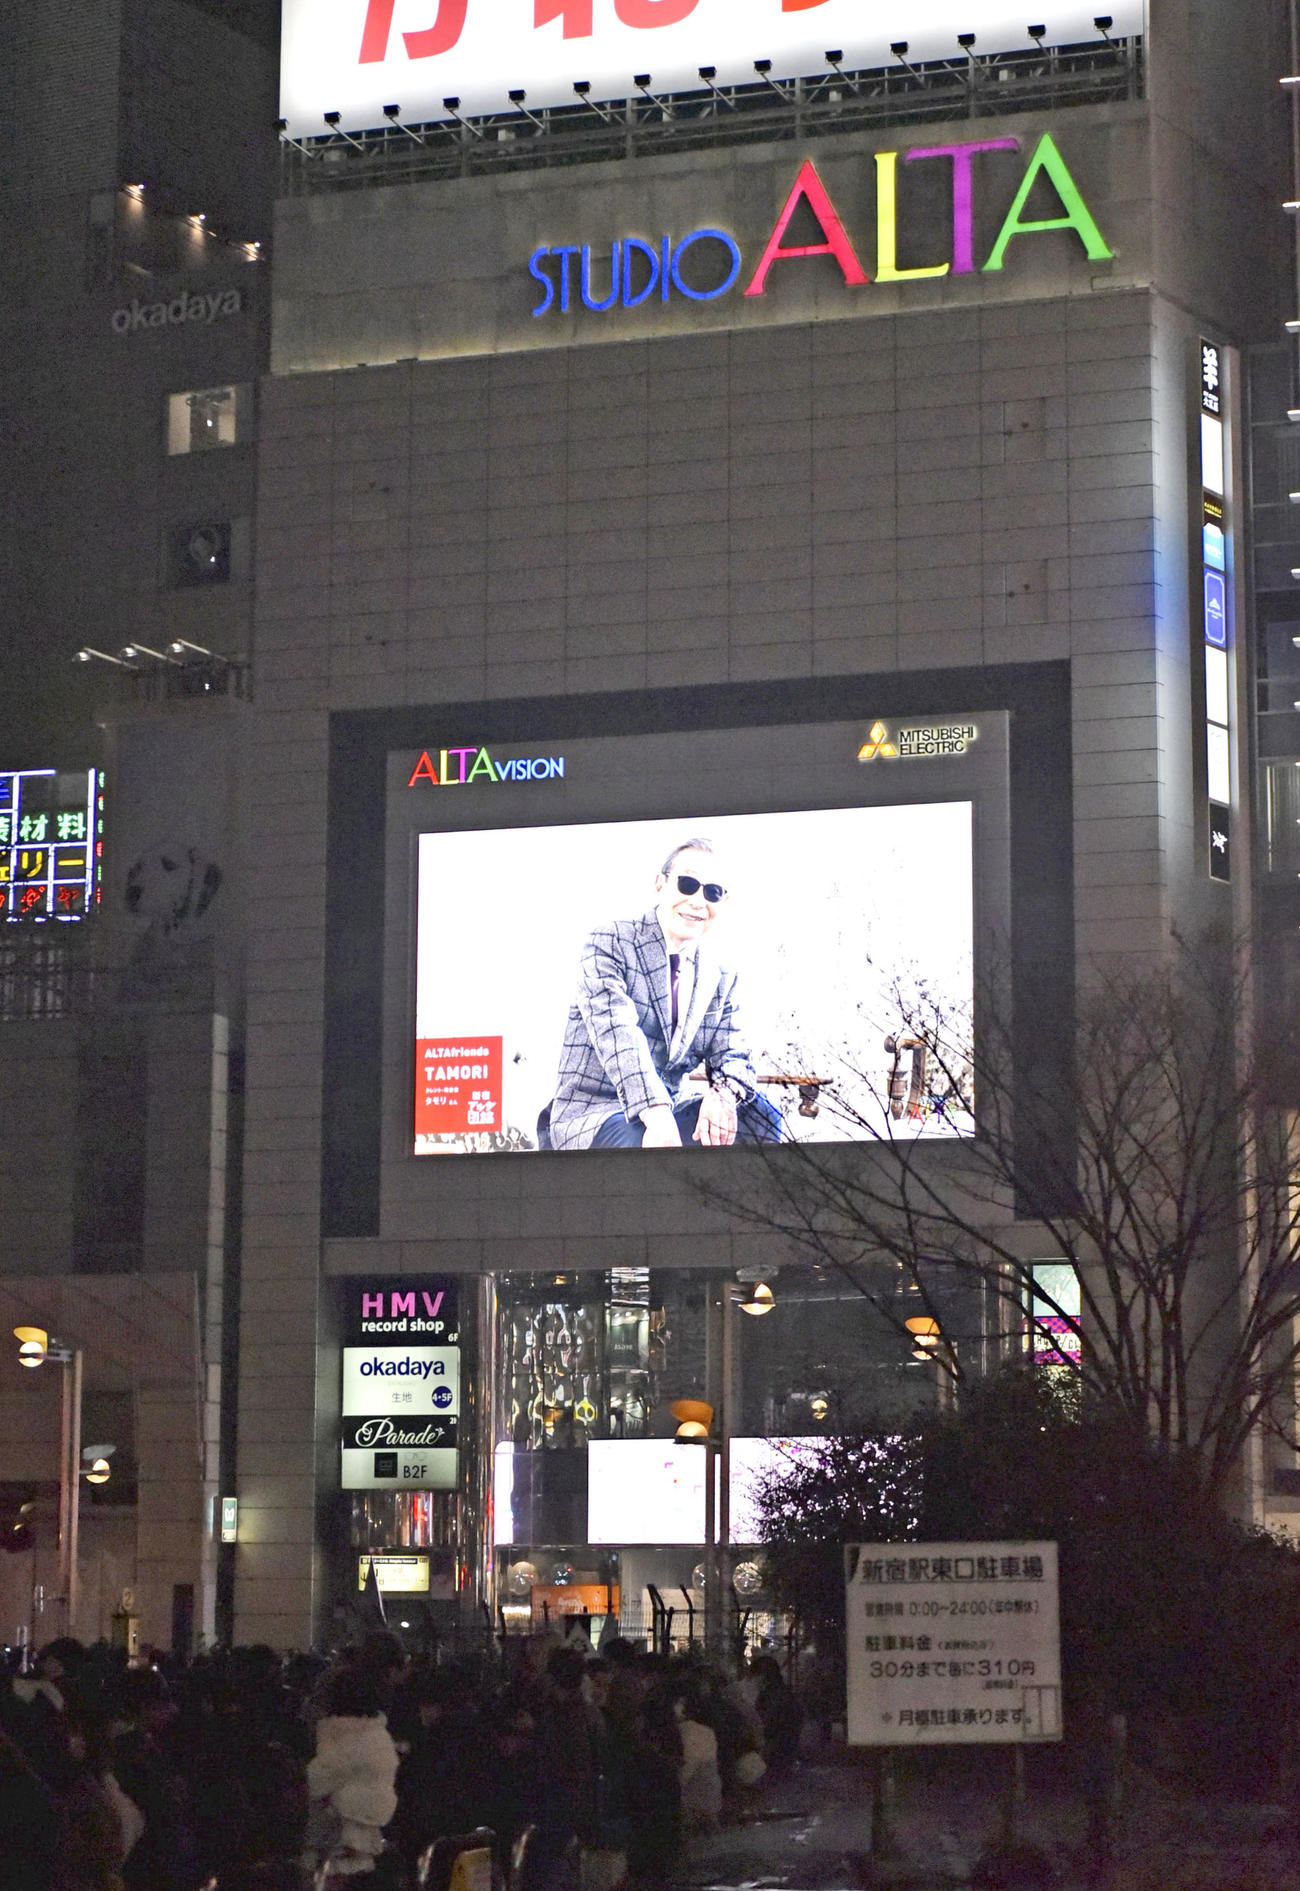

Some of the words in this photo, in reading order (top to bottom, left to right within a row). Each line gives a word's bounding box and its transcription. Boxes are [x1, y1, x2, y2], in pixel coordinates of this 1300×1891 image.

[529, 228, 742, 318] STUDIO
[743, 131, 1115, 297] ALTA
[111, 290, 242, 332] okadaya
[900, 727, 974, 743] MITSUBISHI
[900, 741, 964, 756] ELECTRIC
[0, 886, 80, 913] ダヤ
[424, 1046, 490, 1058] ALTAfriends
[424, 1064, 488, 1081] TAMORI
[425, 1096, 447, 1106] タモリ
[362, 1291, 445, 1318] HMV
[361, 1317, 407, 1332] record
[409, 1317, 445, 1334] shop
[360, 1356, 445, 1380] okadaya
[391, 1391, 413, 1403] 生地
[355, 1417, 445, 1447] Parade
[403, 1465, 428, 1479] B2F
[862, 1555, 1044, 1581] 新宿駅東口駐車場
[864, 1635, 932, 1651] 駐車料金
